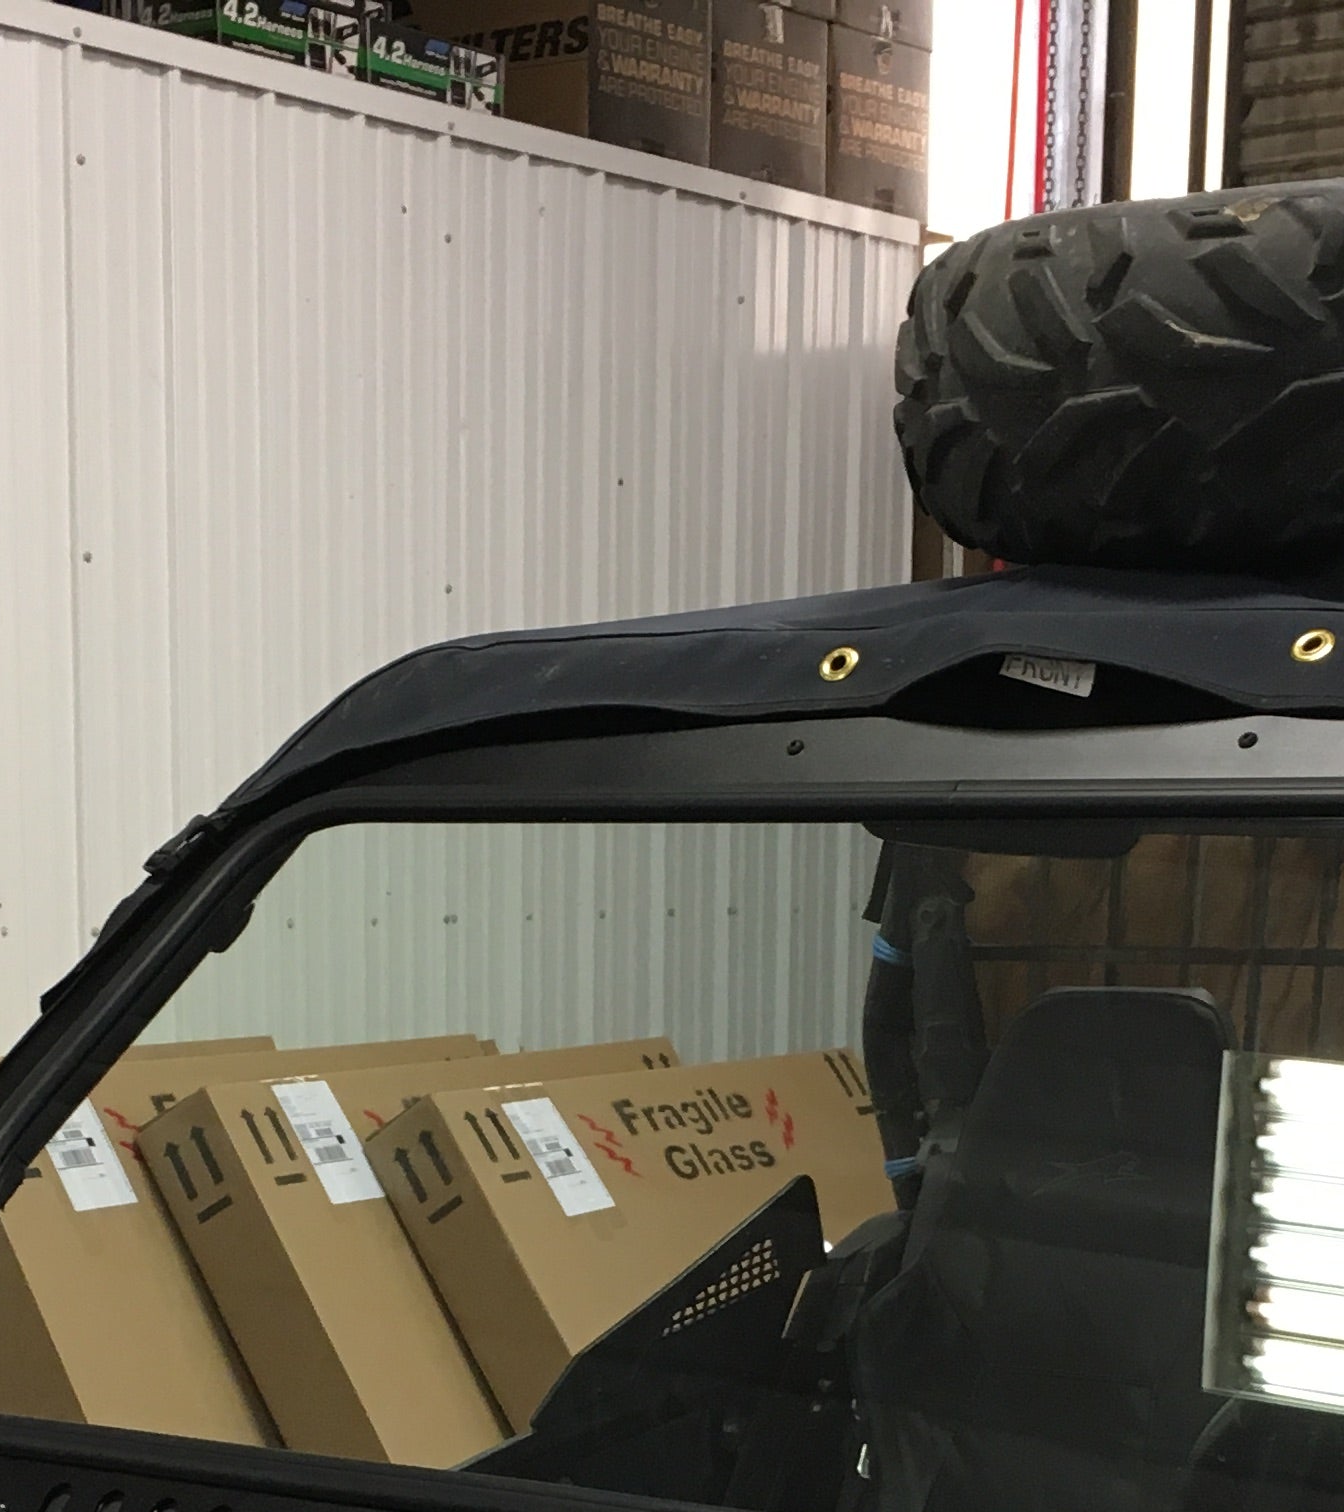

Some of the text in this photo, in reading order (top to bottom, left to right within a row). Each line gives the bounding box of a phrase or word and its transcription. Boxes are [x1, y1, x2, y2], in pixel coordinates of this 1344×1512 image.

[223, 0, 303, 39] 4.2 Harness
[597, 3, 703, 48] BREATHE EASY
[372, 36, 447, 76] 4.2 Harness
[598, 26, 642, 56] YOUR
[723, 39, 820, 81] BREATHE EASY
[611, 52, 704, 95] WARRANTY
[840, 72, 894, 100] BREATHE
[736, 87, 821, 125] WARRANTY
[850, 116, 927, 152] WARRANTY
[1005, 656, 1085, 690] FRONT
[612, 1087, 752, 1135] Fragile
[664, 1141, 776, 1180] Glass
